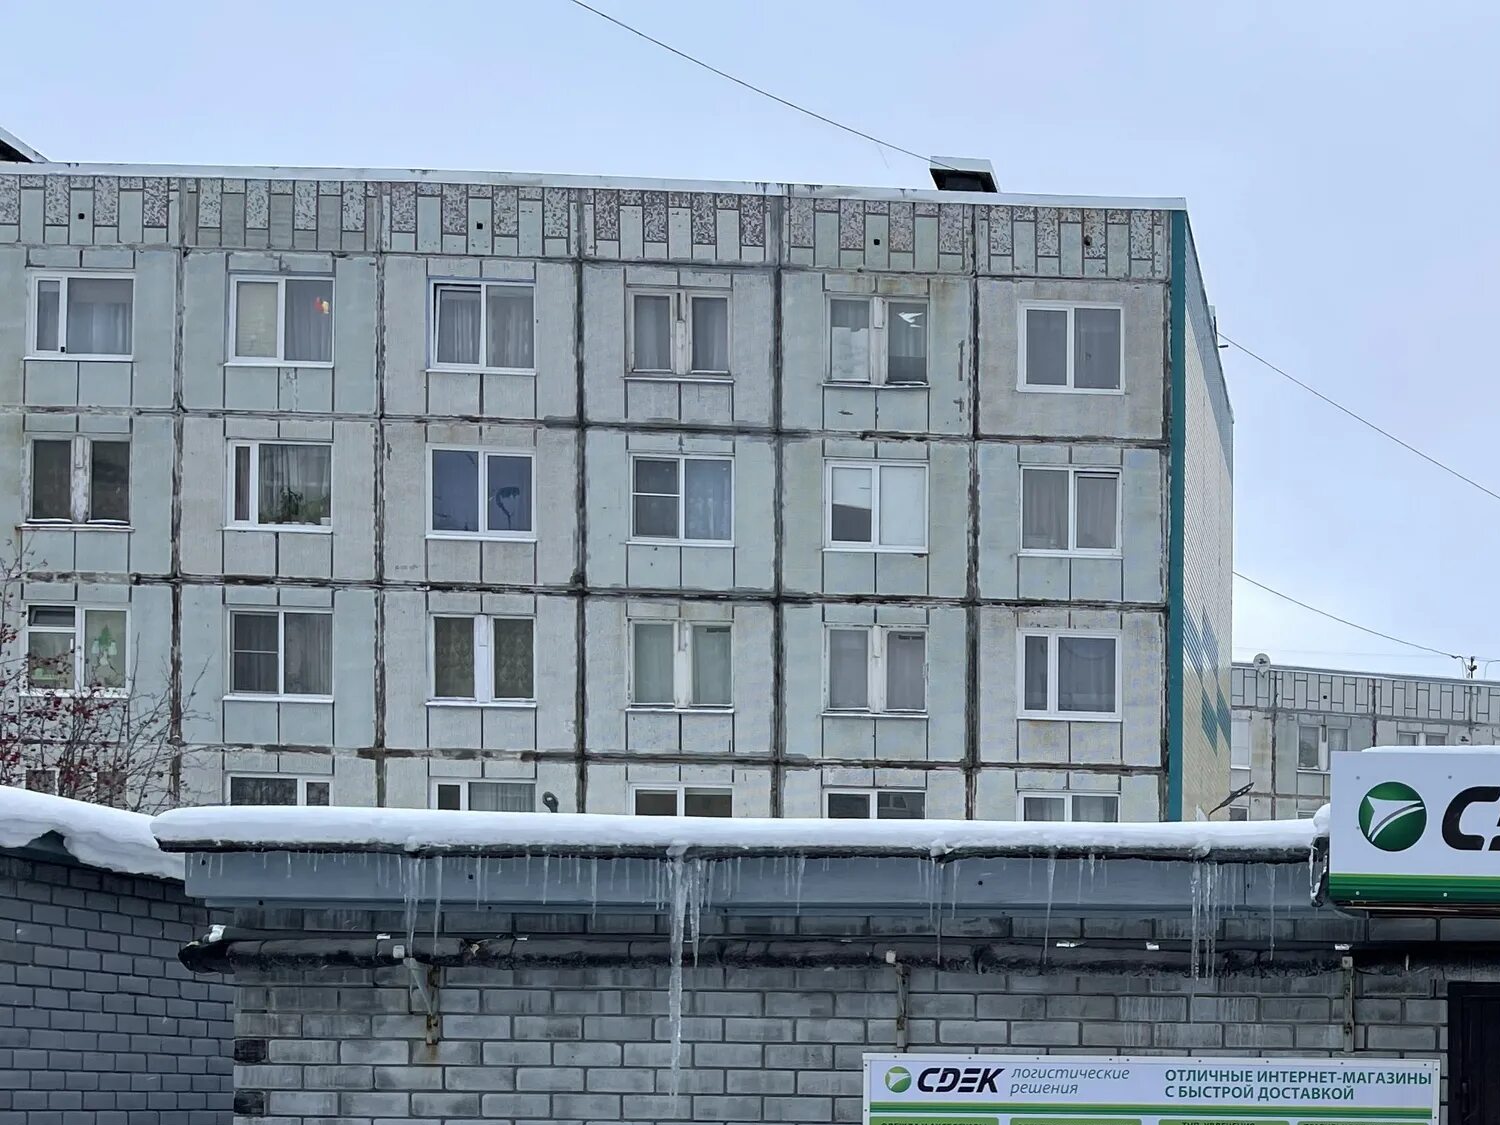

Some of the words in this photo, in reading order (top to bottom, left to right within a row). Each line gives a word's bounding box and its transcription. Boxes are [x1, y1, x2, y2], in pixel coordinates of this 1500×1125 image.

[918, 1068, 1005, 1093] CDEK
[1011, 1067, 1130, 1080] логистические
[1165, 1070, 1253, 1082] ОТЛИЧНЫЕ
[1257, 1071, 1431, 1085] ИНТЕРНЕТ-МАГАЗИНЫ
[1010, 1083, 1078, 1096] решения
[1165, 1086, 1175, 1097] С
[1178, 1084, 1253, 1098] БЫСТРОЙ
[1258, 1086, 1354, 1101] ДОСТАВКОЙ
